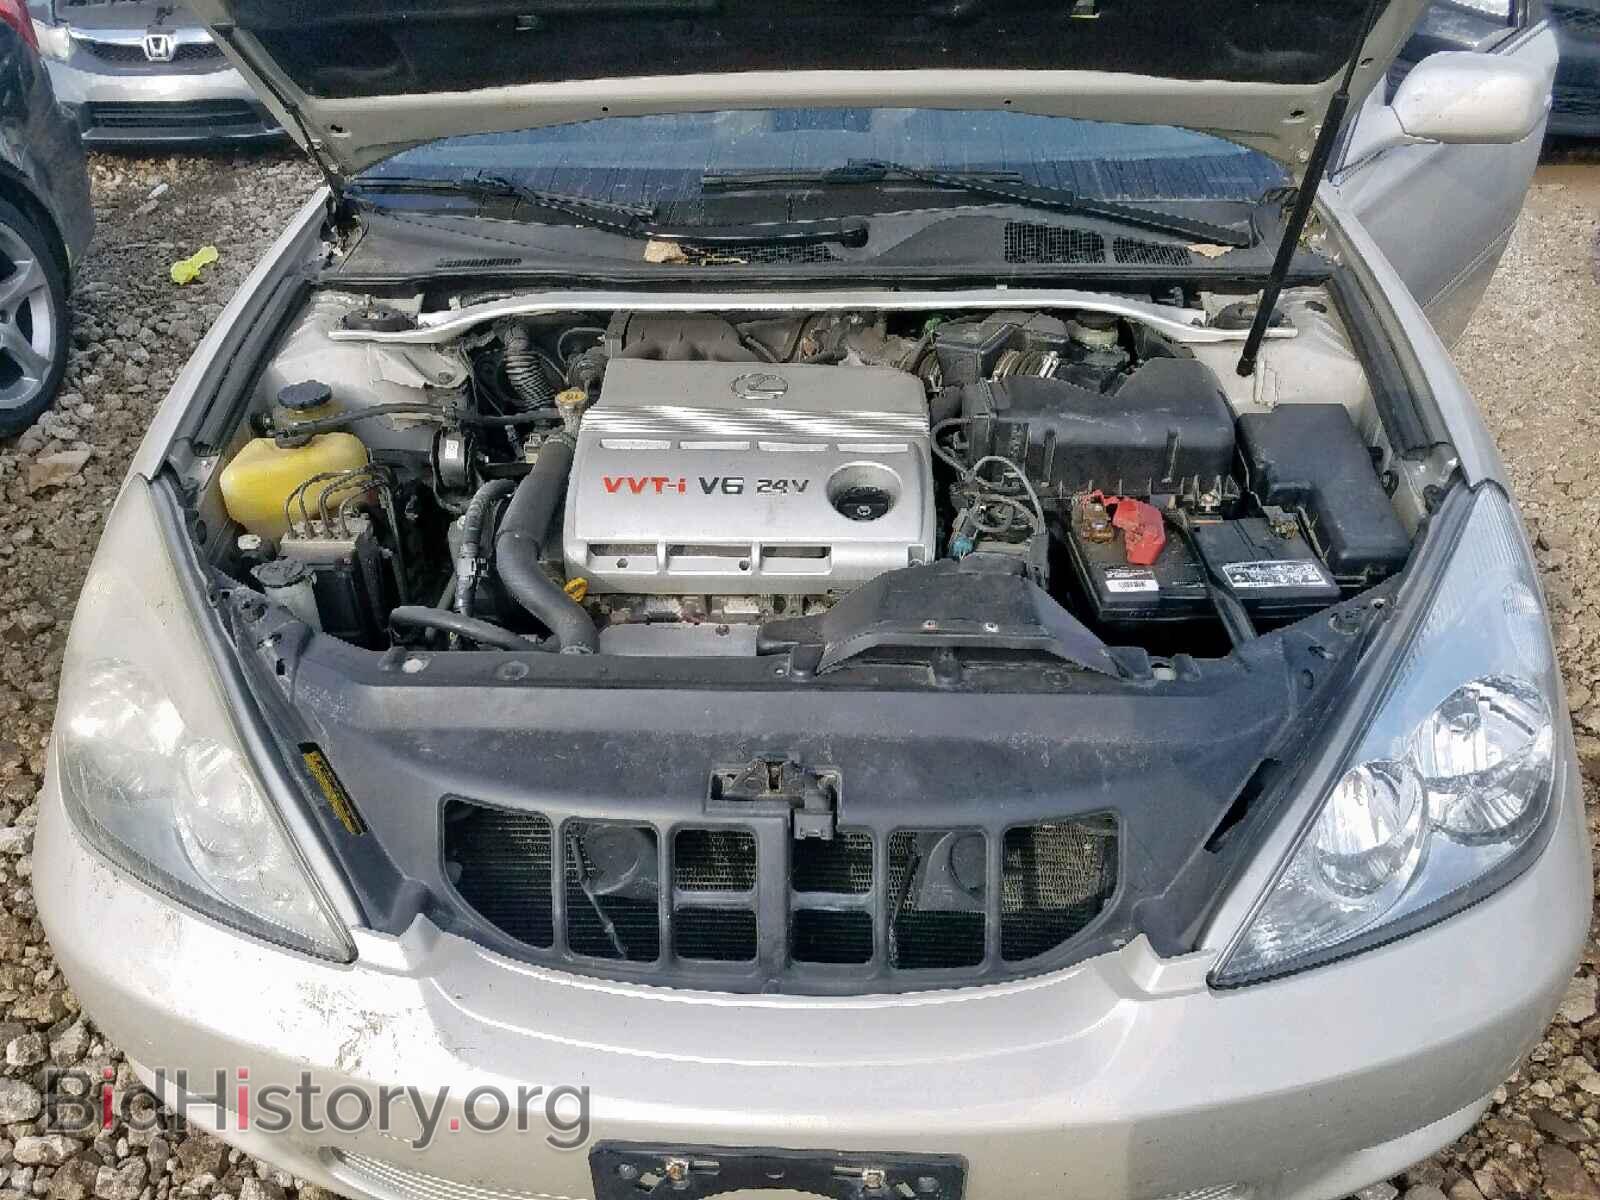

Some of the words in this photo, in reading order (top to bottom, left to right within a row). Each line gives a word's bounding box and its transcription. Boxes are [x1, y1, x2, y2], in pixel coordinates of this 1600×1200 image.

[603, 477, 686, 494] VVT-i
[699, 477, 744, 494] V6
[756, 479, 809, 494] 24V
